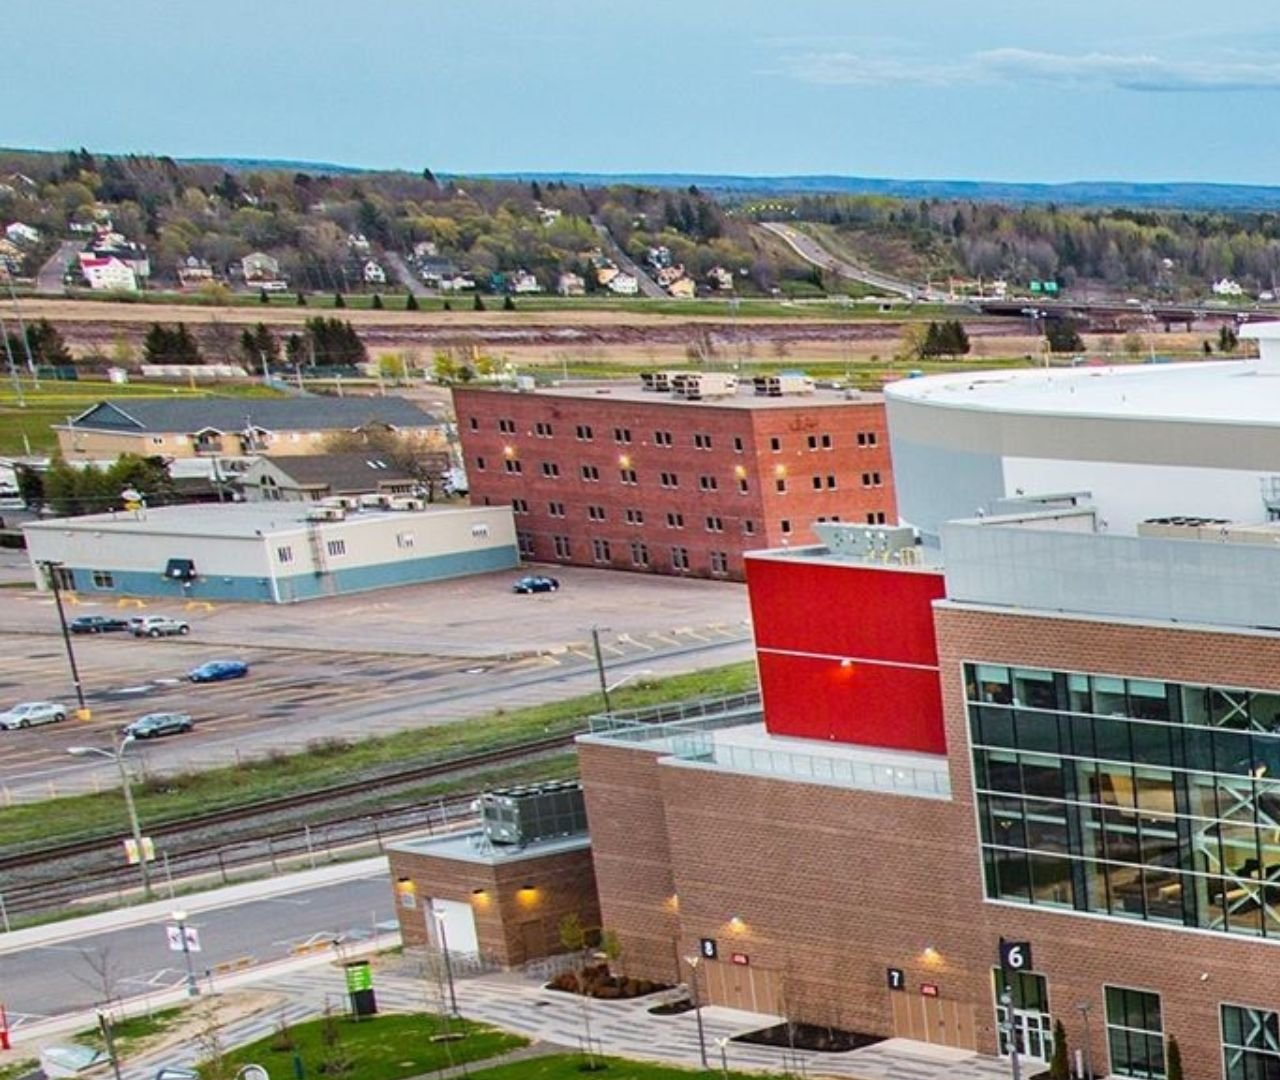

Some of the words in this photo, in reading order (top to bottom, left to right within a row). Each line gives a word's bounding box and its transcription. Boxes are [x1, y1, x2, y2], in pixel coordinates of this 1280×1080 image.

[704, 941, 713, 956] 8
[1007, 945, 1024, 968] 6
[890, 971, 899, 987] 7
